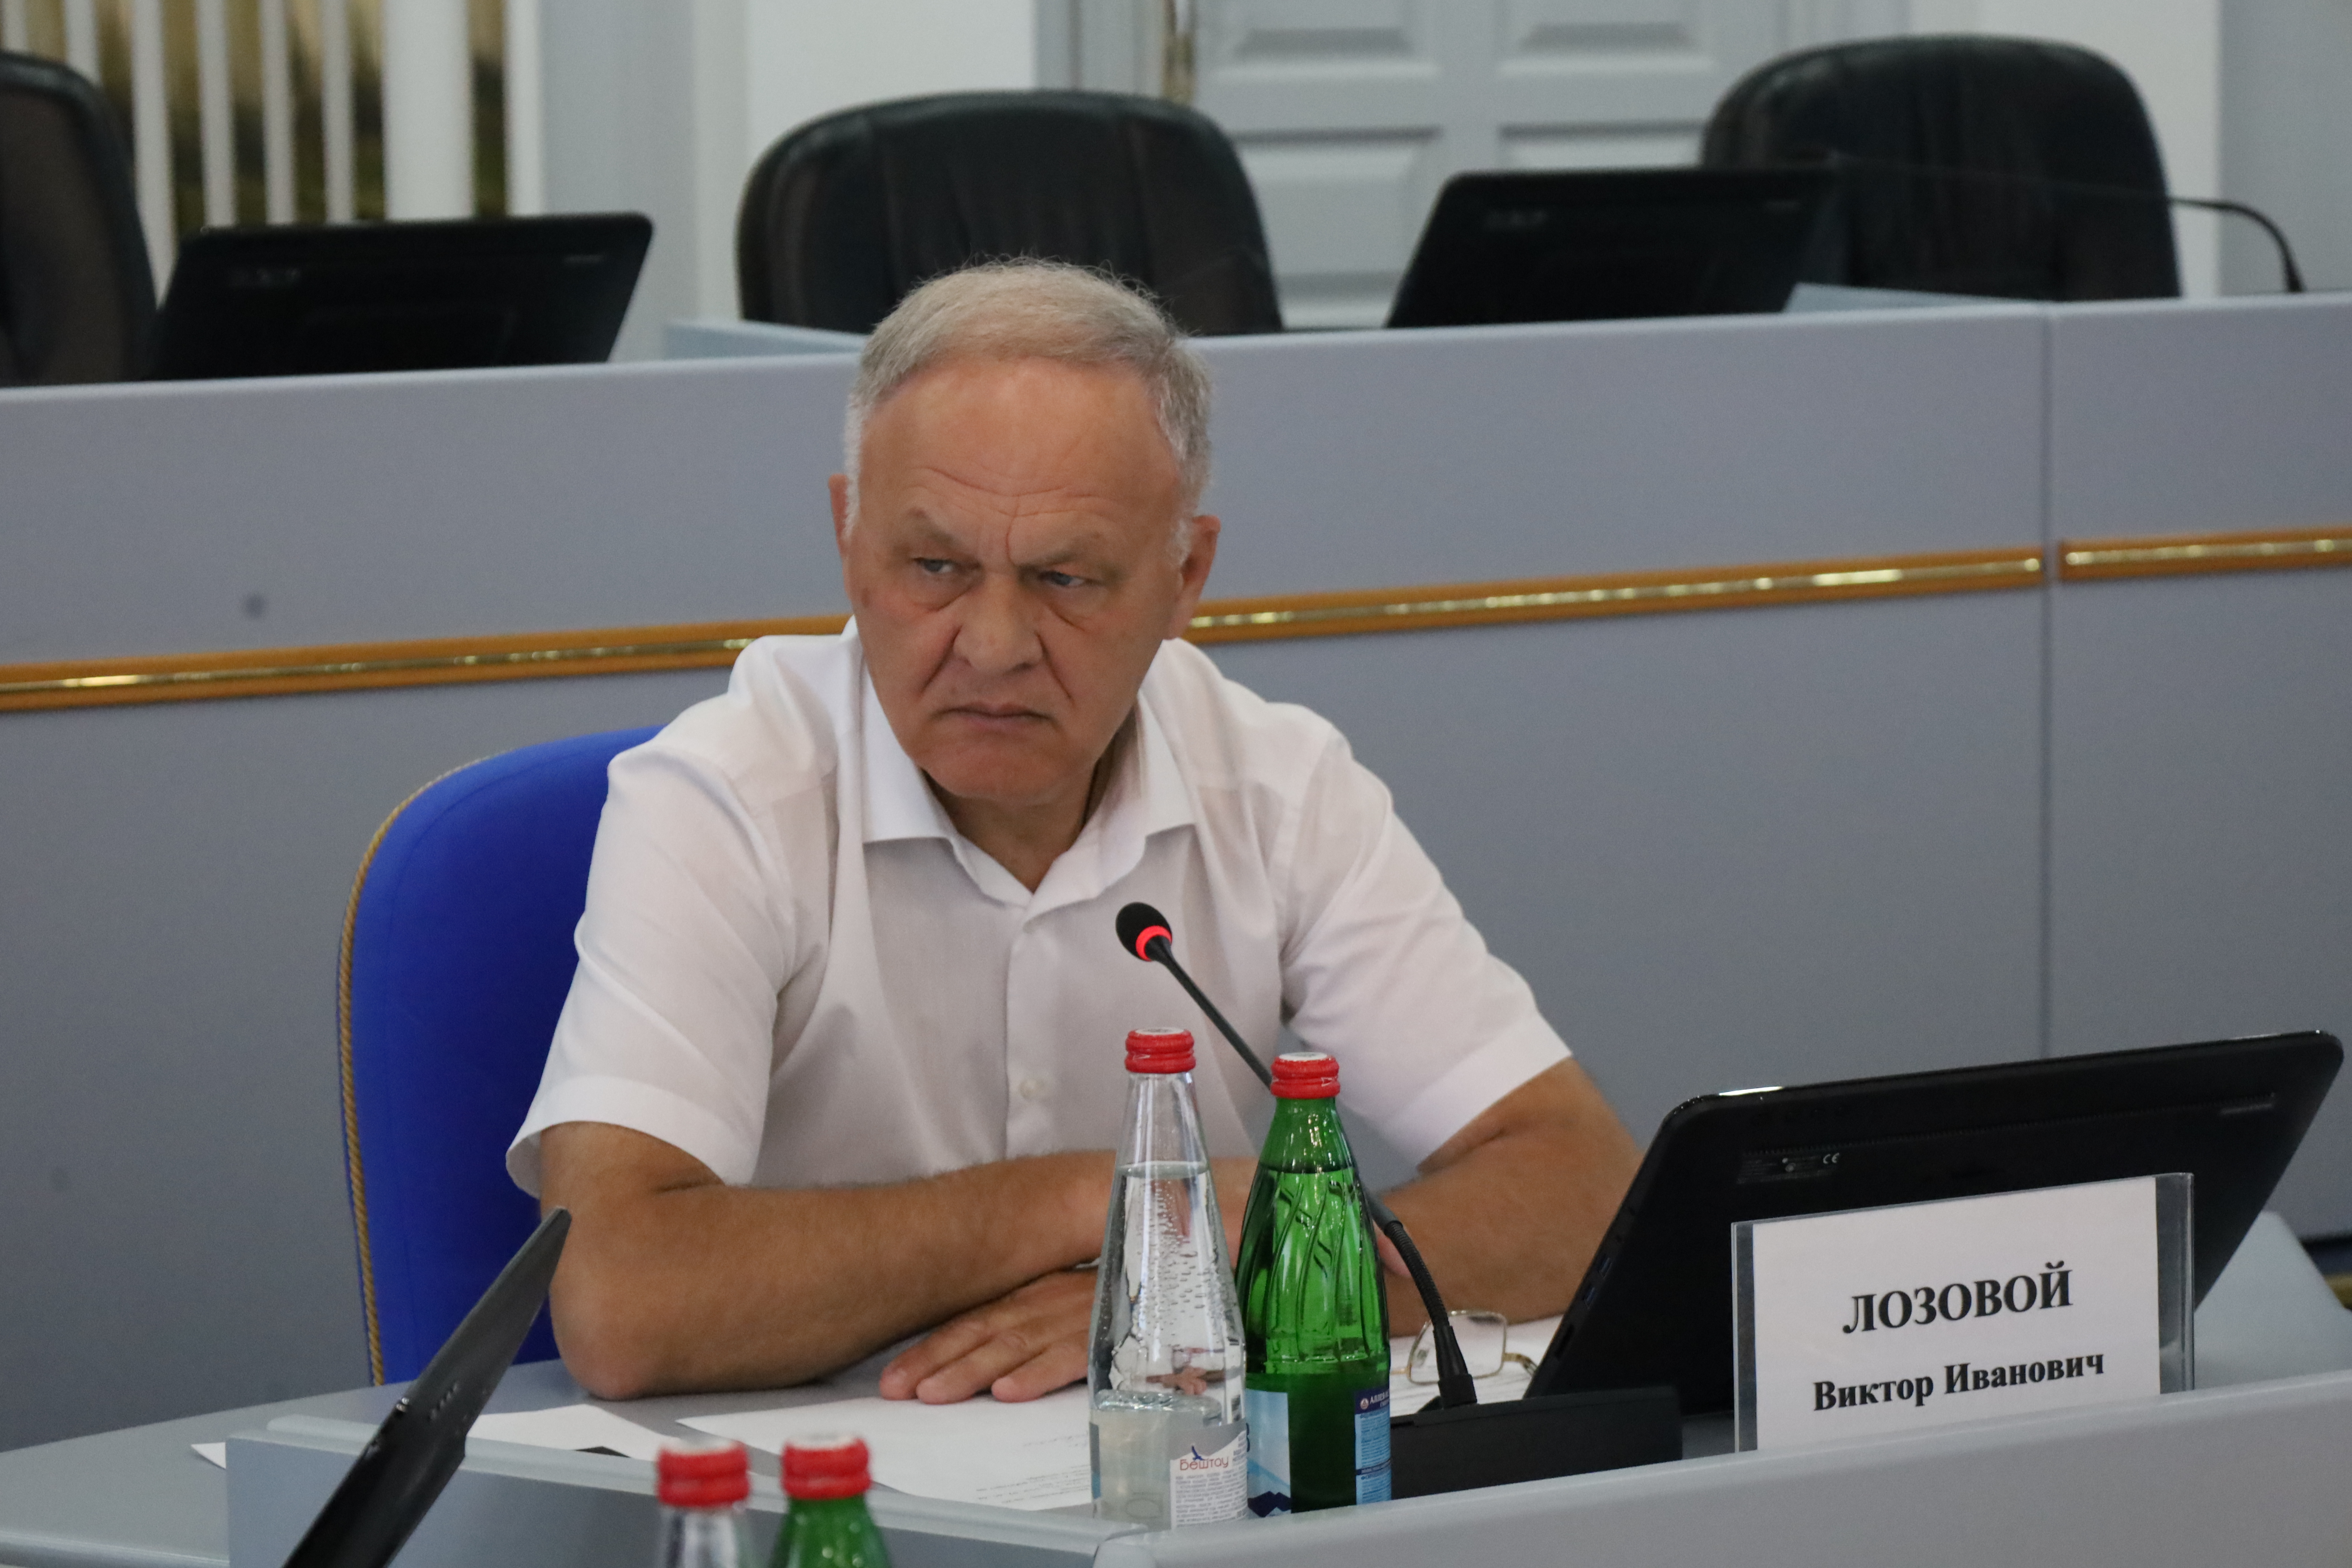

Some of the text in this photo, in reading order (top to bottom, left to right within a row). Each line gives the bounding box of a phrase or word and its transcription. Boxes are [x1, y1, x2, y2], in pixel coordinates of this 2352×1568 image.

[1842, 1260, 2073, 1334] ЛОЗОВОЙ
[1814, 1354, 2104, 1411] Виктор Иванович
[1180, 1456, 1229, 1471] Бештау
